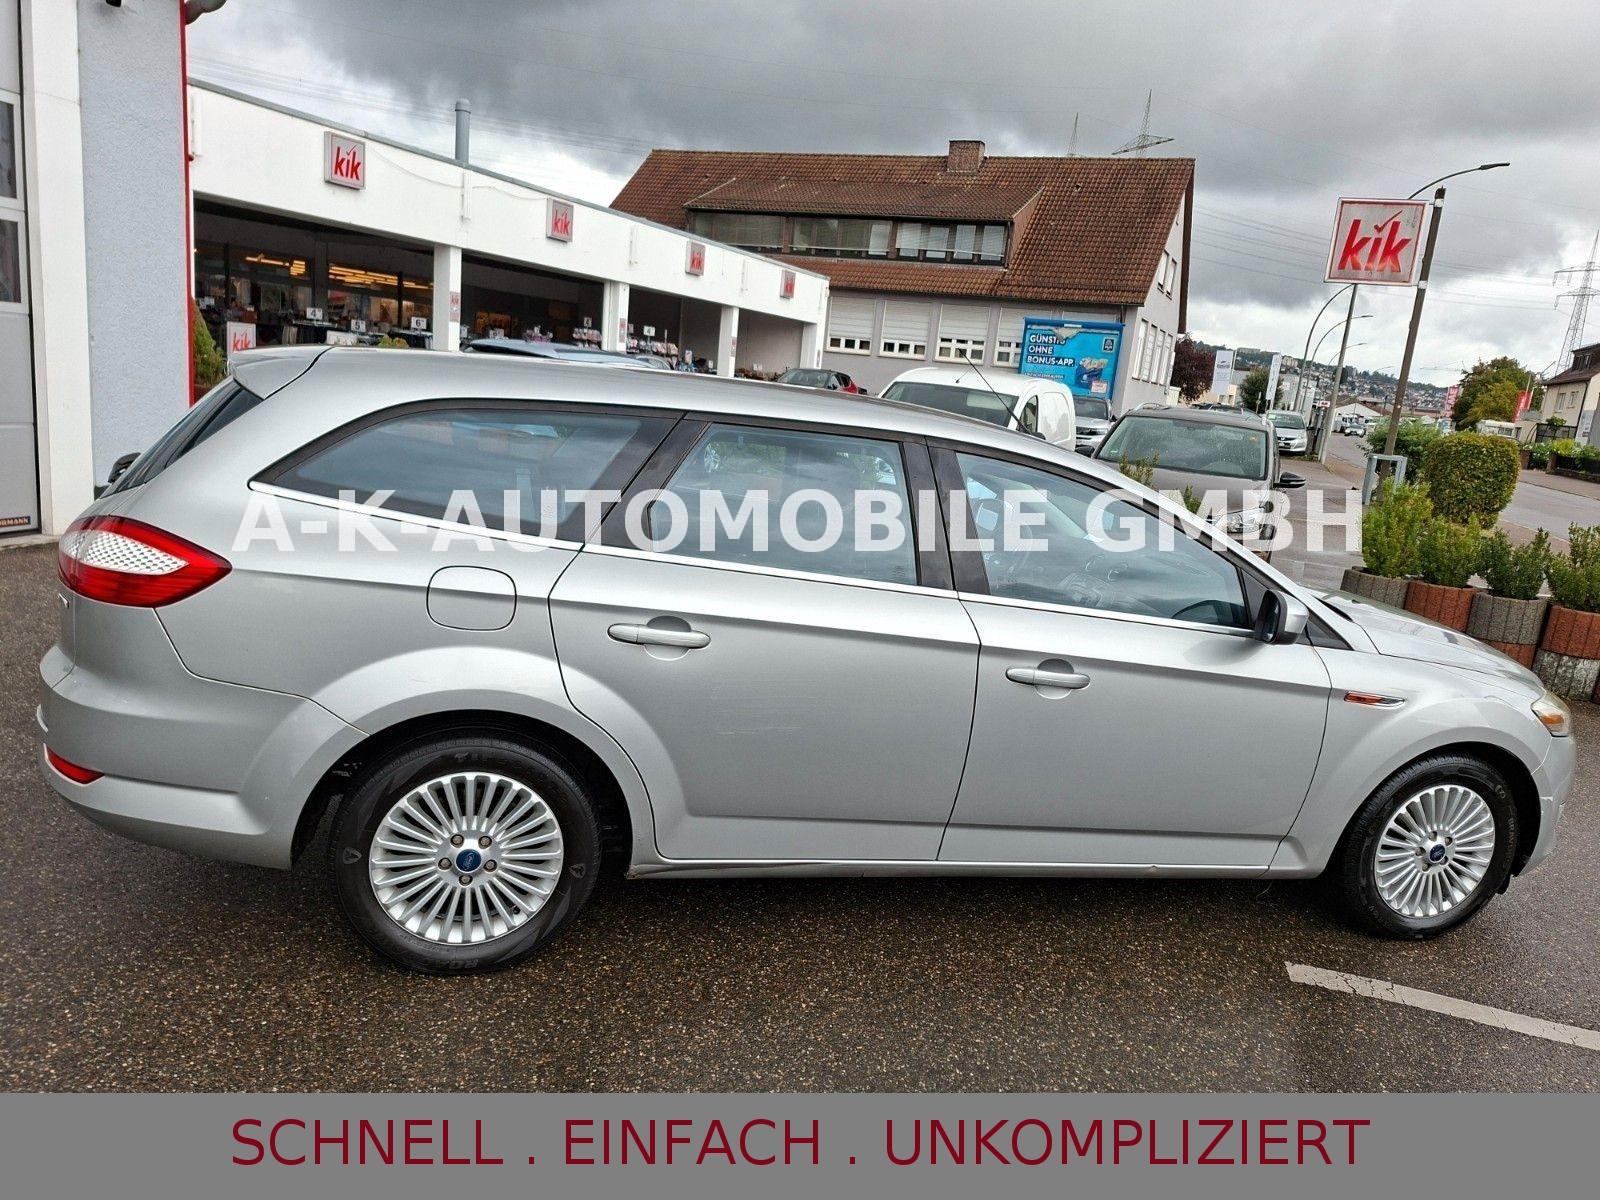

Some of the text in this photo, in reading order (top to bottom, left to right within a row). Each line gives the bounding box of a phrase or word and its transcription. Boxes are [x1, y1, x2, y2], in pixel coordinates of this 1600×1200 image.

[334, 145, 362, 181] kik
[553, 208, 570, 236] kik
[1337, 210, 1412, 273] kik
[232, 328, 251, 351] kik
[1028, 345, 1054, 354] OHNE
[1027, 355, 1074, 366] BONUS-APP.
